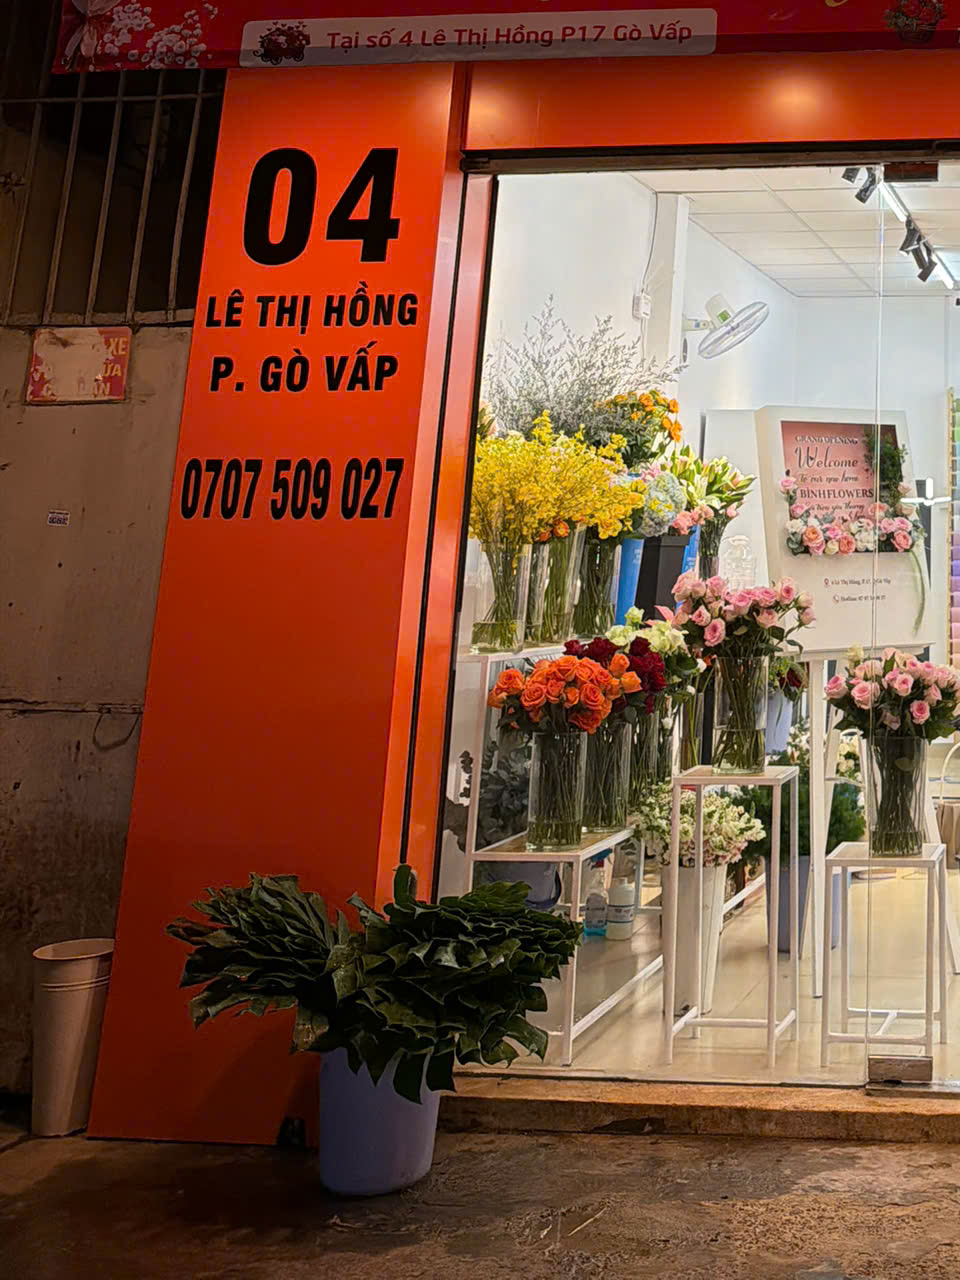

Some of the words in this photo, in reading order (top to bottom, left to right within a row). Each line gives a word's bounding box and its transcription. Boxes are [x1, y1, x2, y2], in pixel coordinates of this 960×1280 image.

[327, 31, 360, 51] Tại
[366, 28, 397, 48] số
[399, 30, 412, 47] 4
[420, 27, 447, 46] Lê
[454, 28, 488, 50] Thị
[495, 24, 554, 47] Hồng
[561, 25, 606, 43] P17
[613, 24, 642, 42] Gò
[649, 20, 693, 44] Vấp
[243, 147, 400, 266] 04
[206, 289, 245, 328] LÊ
[256, 295, 311, 335] THỊ
[323, 281, 418, 327] HỒNG
[108, 337, 128, 355] XE
[209, 356, 245, 392] P.
[260, 349, 309, 392] GÒ
[325, 341, 398, 392] VẤP
[794, 446, 859, 468] Welcome
[181, 457, 263, 520] 0707
[270, 457, 331, 520] 509
[341, 457, 404, 520] 027
